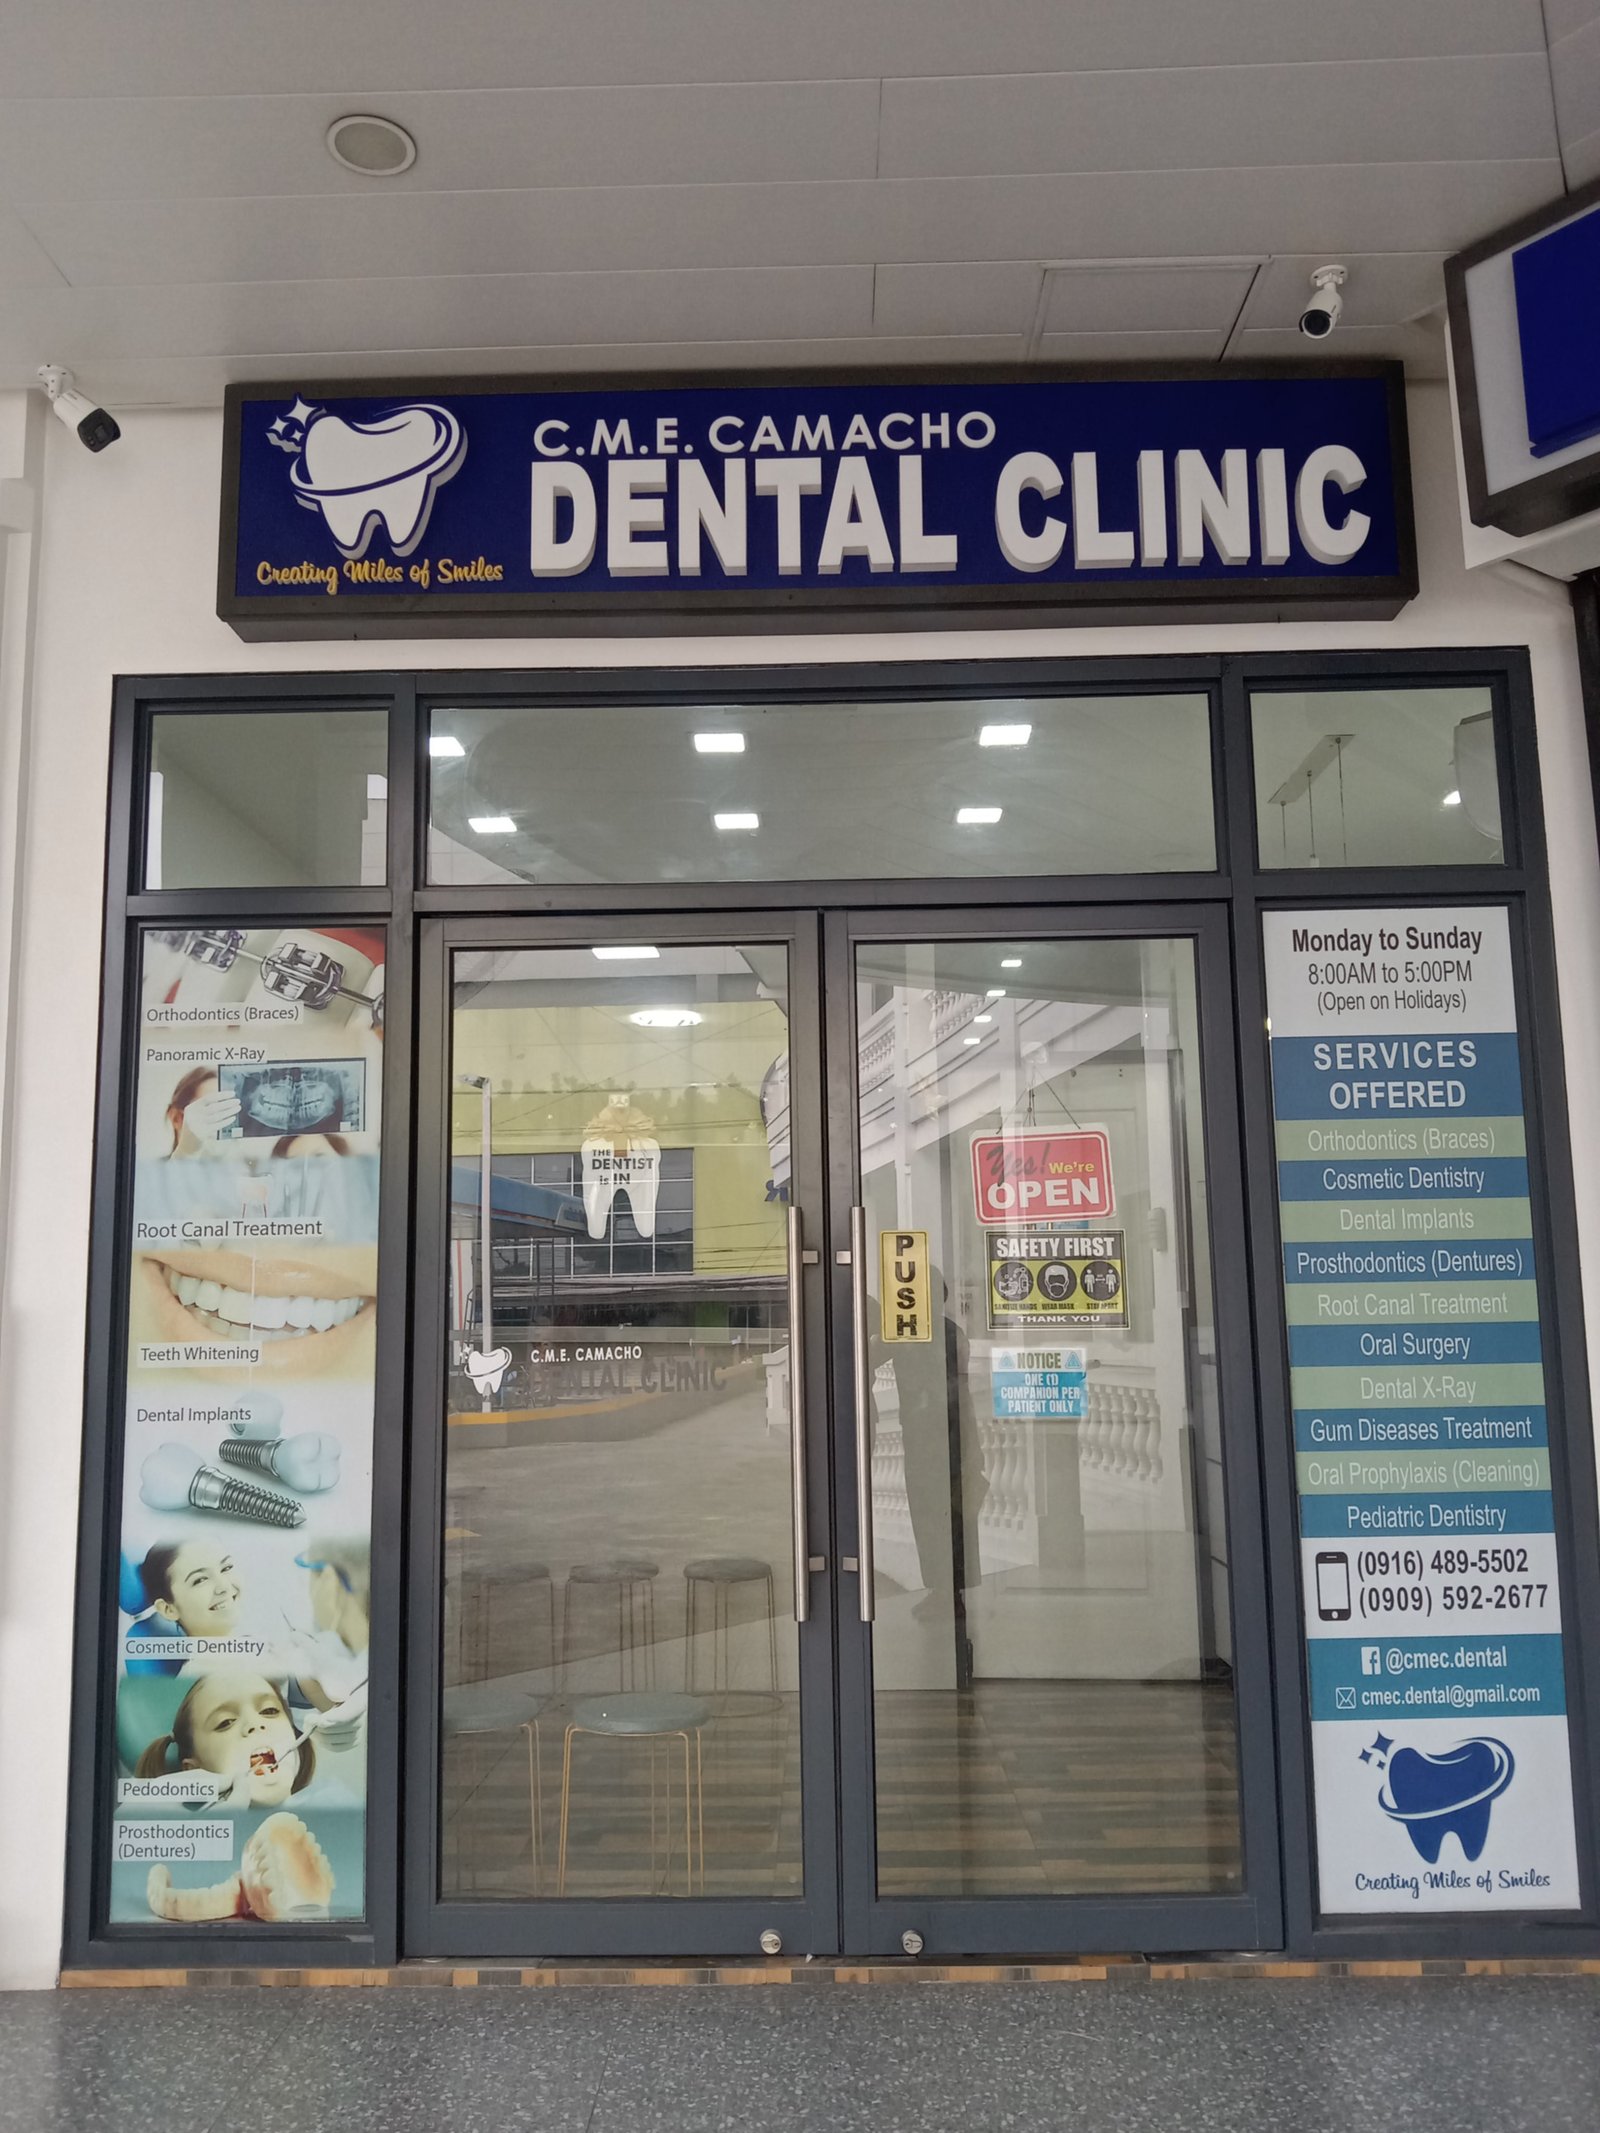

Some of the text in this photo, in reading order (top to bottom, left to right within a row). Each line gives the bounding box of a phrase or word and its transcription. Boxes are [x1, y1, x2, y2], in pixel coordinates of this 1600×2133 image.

[534, 411, 996, 456] C.M.E. CAMACHO
[530, 444, 1371, 578] DENTAL CLINIC
[257, 556, 503, 594] Creating Miles of Smiles
[1292, 926, 1482, 957] Monday to Sunday
[1308, 960, 1473, 985] 8:00AM to 5:00PM
[147, 1006, 299, 1022] Orthodontics (Braces)
[1317, 989, 1467, 1015] (Open on Holidays)
[147, 1047, 265, 1063] Panoramic X-Ray
[1313, 1040, 1477, 1071] SERVICES
[1329, 1080, 1467, 1109] OFFERED
[592, 1149, 611, 1157] THE
[1308, 1127, 1495, 1154] Orthodontics (Braces)
[592, 1158, 654, 1170] DENTIST
[1049, 1162, 1095, 1174] We're
[600, 1173, 631, 1185] is IN
[1323, 1166, 1485, 1193] Cosmetic Dentistry
[987, 1177, 1100, 1209] OPEN
[137, 1221, 322, 1238] Root Canal Treatment
[1341, 1207, 1475, 1234] Dental Implants
[996, 1237, 1115, 1257] SAFETY FIRST
[1297, 1248, 1523, 1277] Prosthodontics (Dentures)
[895, 1235, 918, 1336] PUSH
[1317, 1292, 1508, 1316] Root Canal Treatment
[1018, 1315, 1067, 1323] THANK
[140, 1346, 259, 1362] Teeth Whitening
[530, 1346, 642, 1363] C.M.E. CAMACHO
[1360, 1332, 1471, 1360] Oral Surgery
[1017, 1352, 1061, 1369] NOTICE
[1024, 1373, 1043, 1386] ONE
[1361, 1376, 1477, 1403] Dental X-Ray
[1001, 1386, 1081, 1400] COMPANION PER
[137, 1407, 251, 1424] Dental Implants
[1008, 1400, 1074, 1413] PATIENT ONLY
[1310, 1416, 1533, 1442] Gum Diseases Treatment
[1308, 1459, 1540, 1489] Oral Prophylaxis (Cleaning)
[1347, 1504, 1506, 1532] Pediatric Dentistry
[1357, 1548, 1528, 1582] (0916) 489-5502
[1359, 1584, 1549, 1618] (0909) 592-2677
[126, 1640, 265, 1657] Cosmetic Dentistry
[1386, 1646, 1508, 1674] @cmec.dental
[1361, 1684, 1541, 1708] cmec.dental@gmail.com
[123, 1783, 215, 1797] Pedodontics
[119, 1825, 230, 1840] Prosthodontics
[118, 1843, 196, 1859] (Dentures)
[1355, 1869, 1551, 1899] Creating Miles of Smiles
